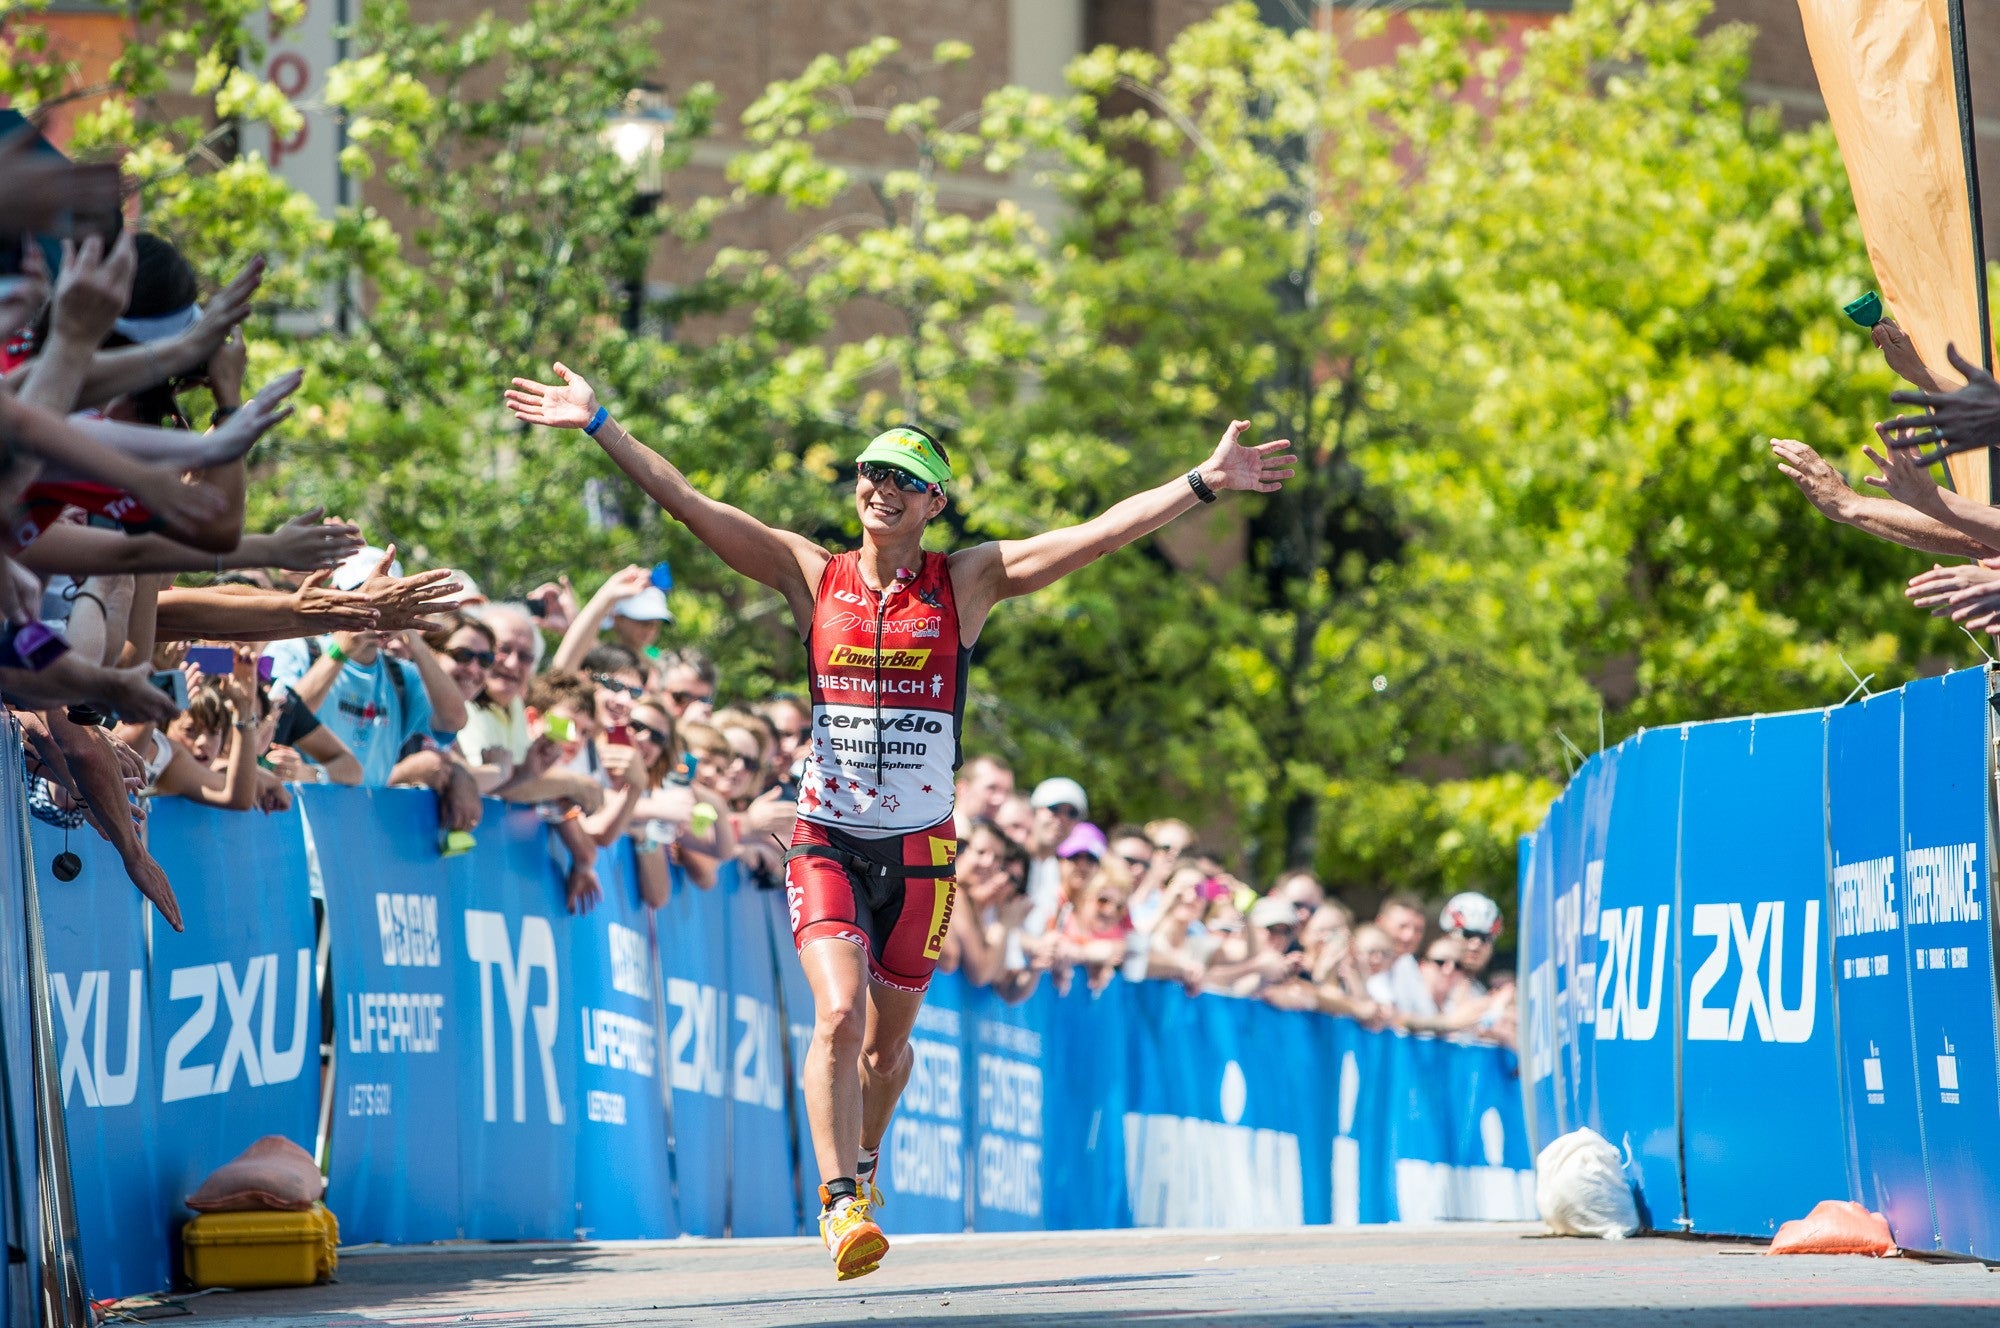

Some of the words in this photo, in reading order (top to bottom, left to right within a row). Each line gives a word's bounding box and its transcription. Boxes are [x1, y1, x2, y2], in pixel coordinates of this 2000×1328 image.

[816, 674, 925, 694] BIESTMILCH
[818, 713, 943, 735] cervélo
[830, 737, 928, 756] SHIMANO
[844, 759, 876, 770] Aqua
[881, 761, 924, 770] Sphere
[161, 948, 311, 1104] 2XU
[464, 908, 567, 1125] TYR
[1596, 904, 1670, 1041] 2XU
[1688, 900, 1819, 1043] 2XU
[50, 969, 142, 1110] XU
[667, 977, 729, 1099] 2XU
[897, 1037, 962, 1119] OSTER
